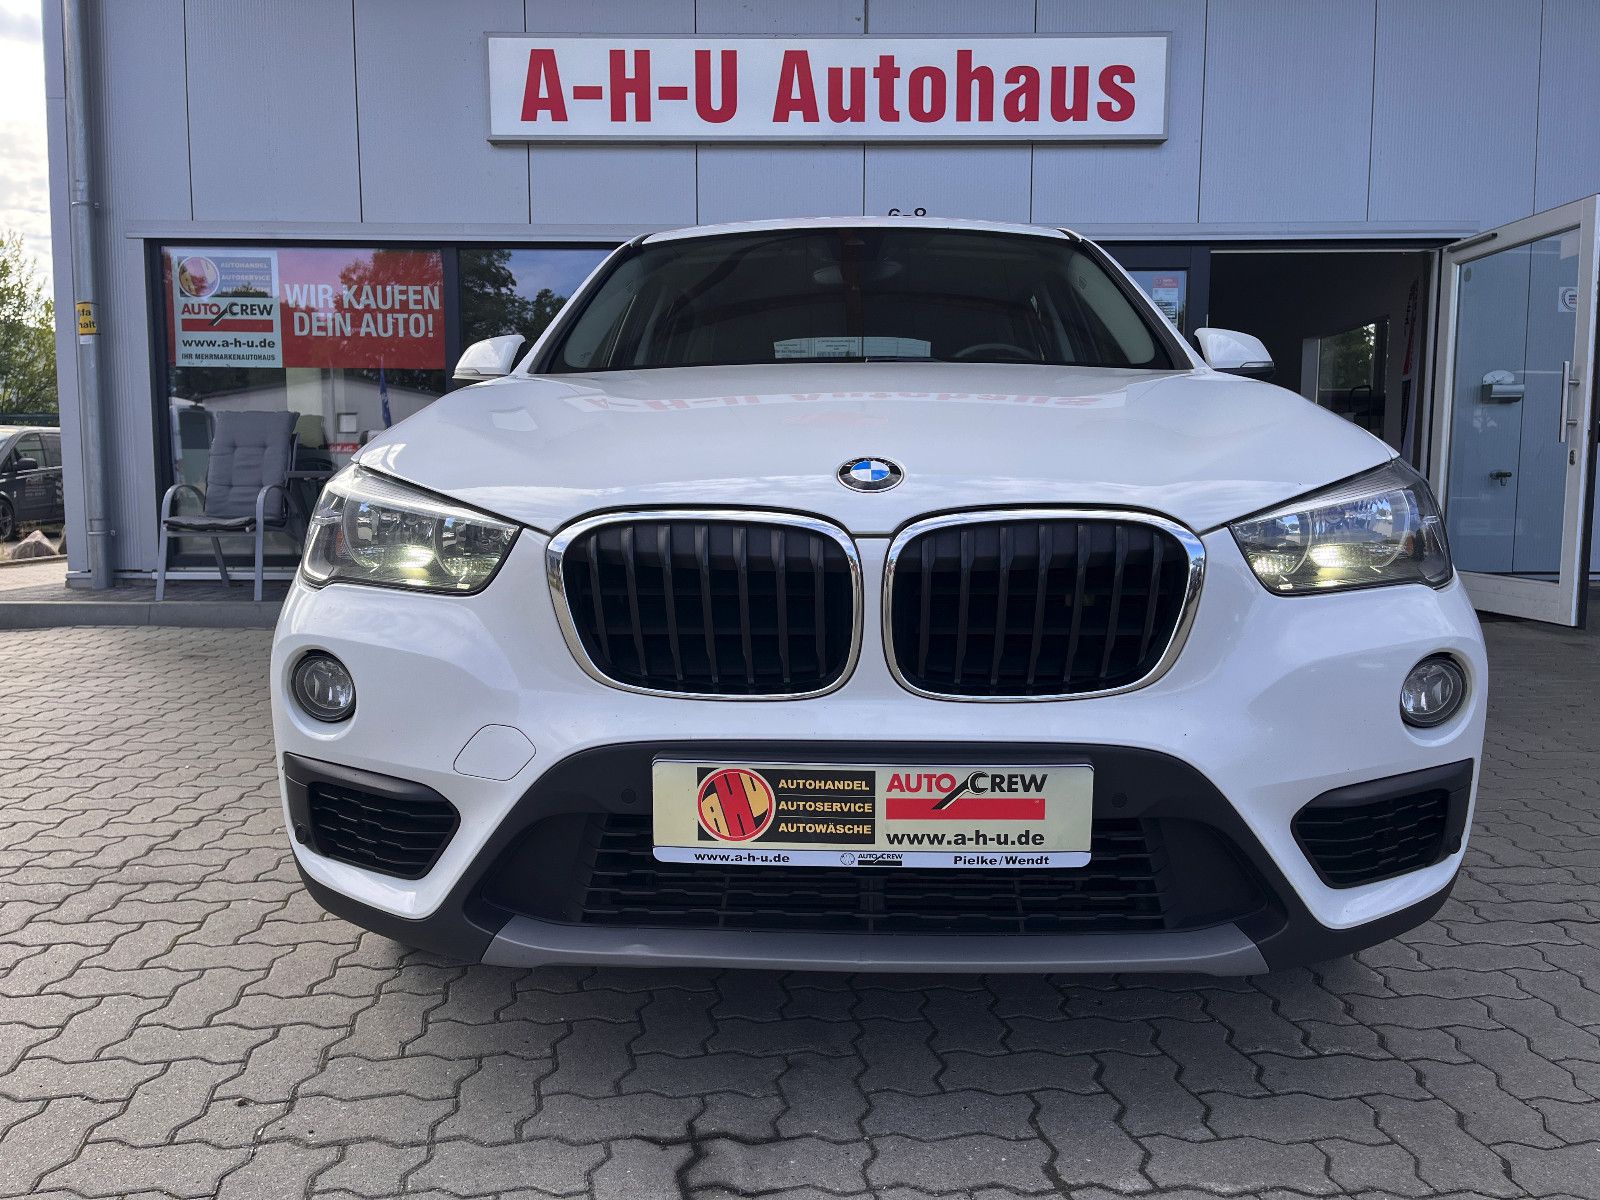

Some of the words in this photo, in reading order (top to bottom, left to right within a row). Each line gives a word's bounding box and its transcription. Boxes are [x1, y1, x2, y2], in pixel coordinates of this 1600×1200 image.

[521, 48, 738, 124] A-H-U
[772, 48, 1136, 124] Autohaus
[284, 283, 334, 309] WIR
[342, 284, 440, 310] KAUFEN
[181, 303, 221, 315] AUTO
[227, 302, 273, 316] CREW
[293, 312, 352, 337] DEIN
[360, 313, 434, 338] AUTO!
[182, 337, 276, 348] www.a-h-u.de
[195, 353, 276, 361] MEHRMARKENAUTOHAUS
[778, 779, 869, 791] AUTOHANDEL
[886, 773, 956, 793] AUTO
[969, 771, 1048, 793] CREW
[778, 801, 873, 813] AUTOSERVICE
[778, 821, 872, 835] AUTOWÄSCHE
[886, 829, 1045, 846] www.a-h-u.de
[694, 853, 790, 863] www.a-h-u.de
[953, 855, 1050, 866] Pielke/Wendt
